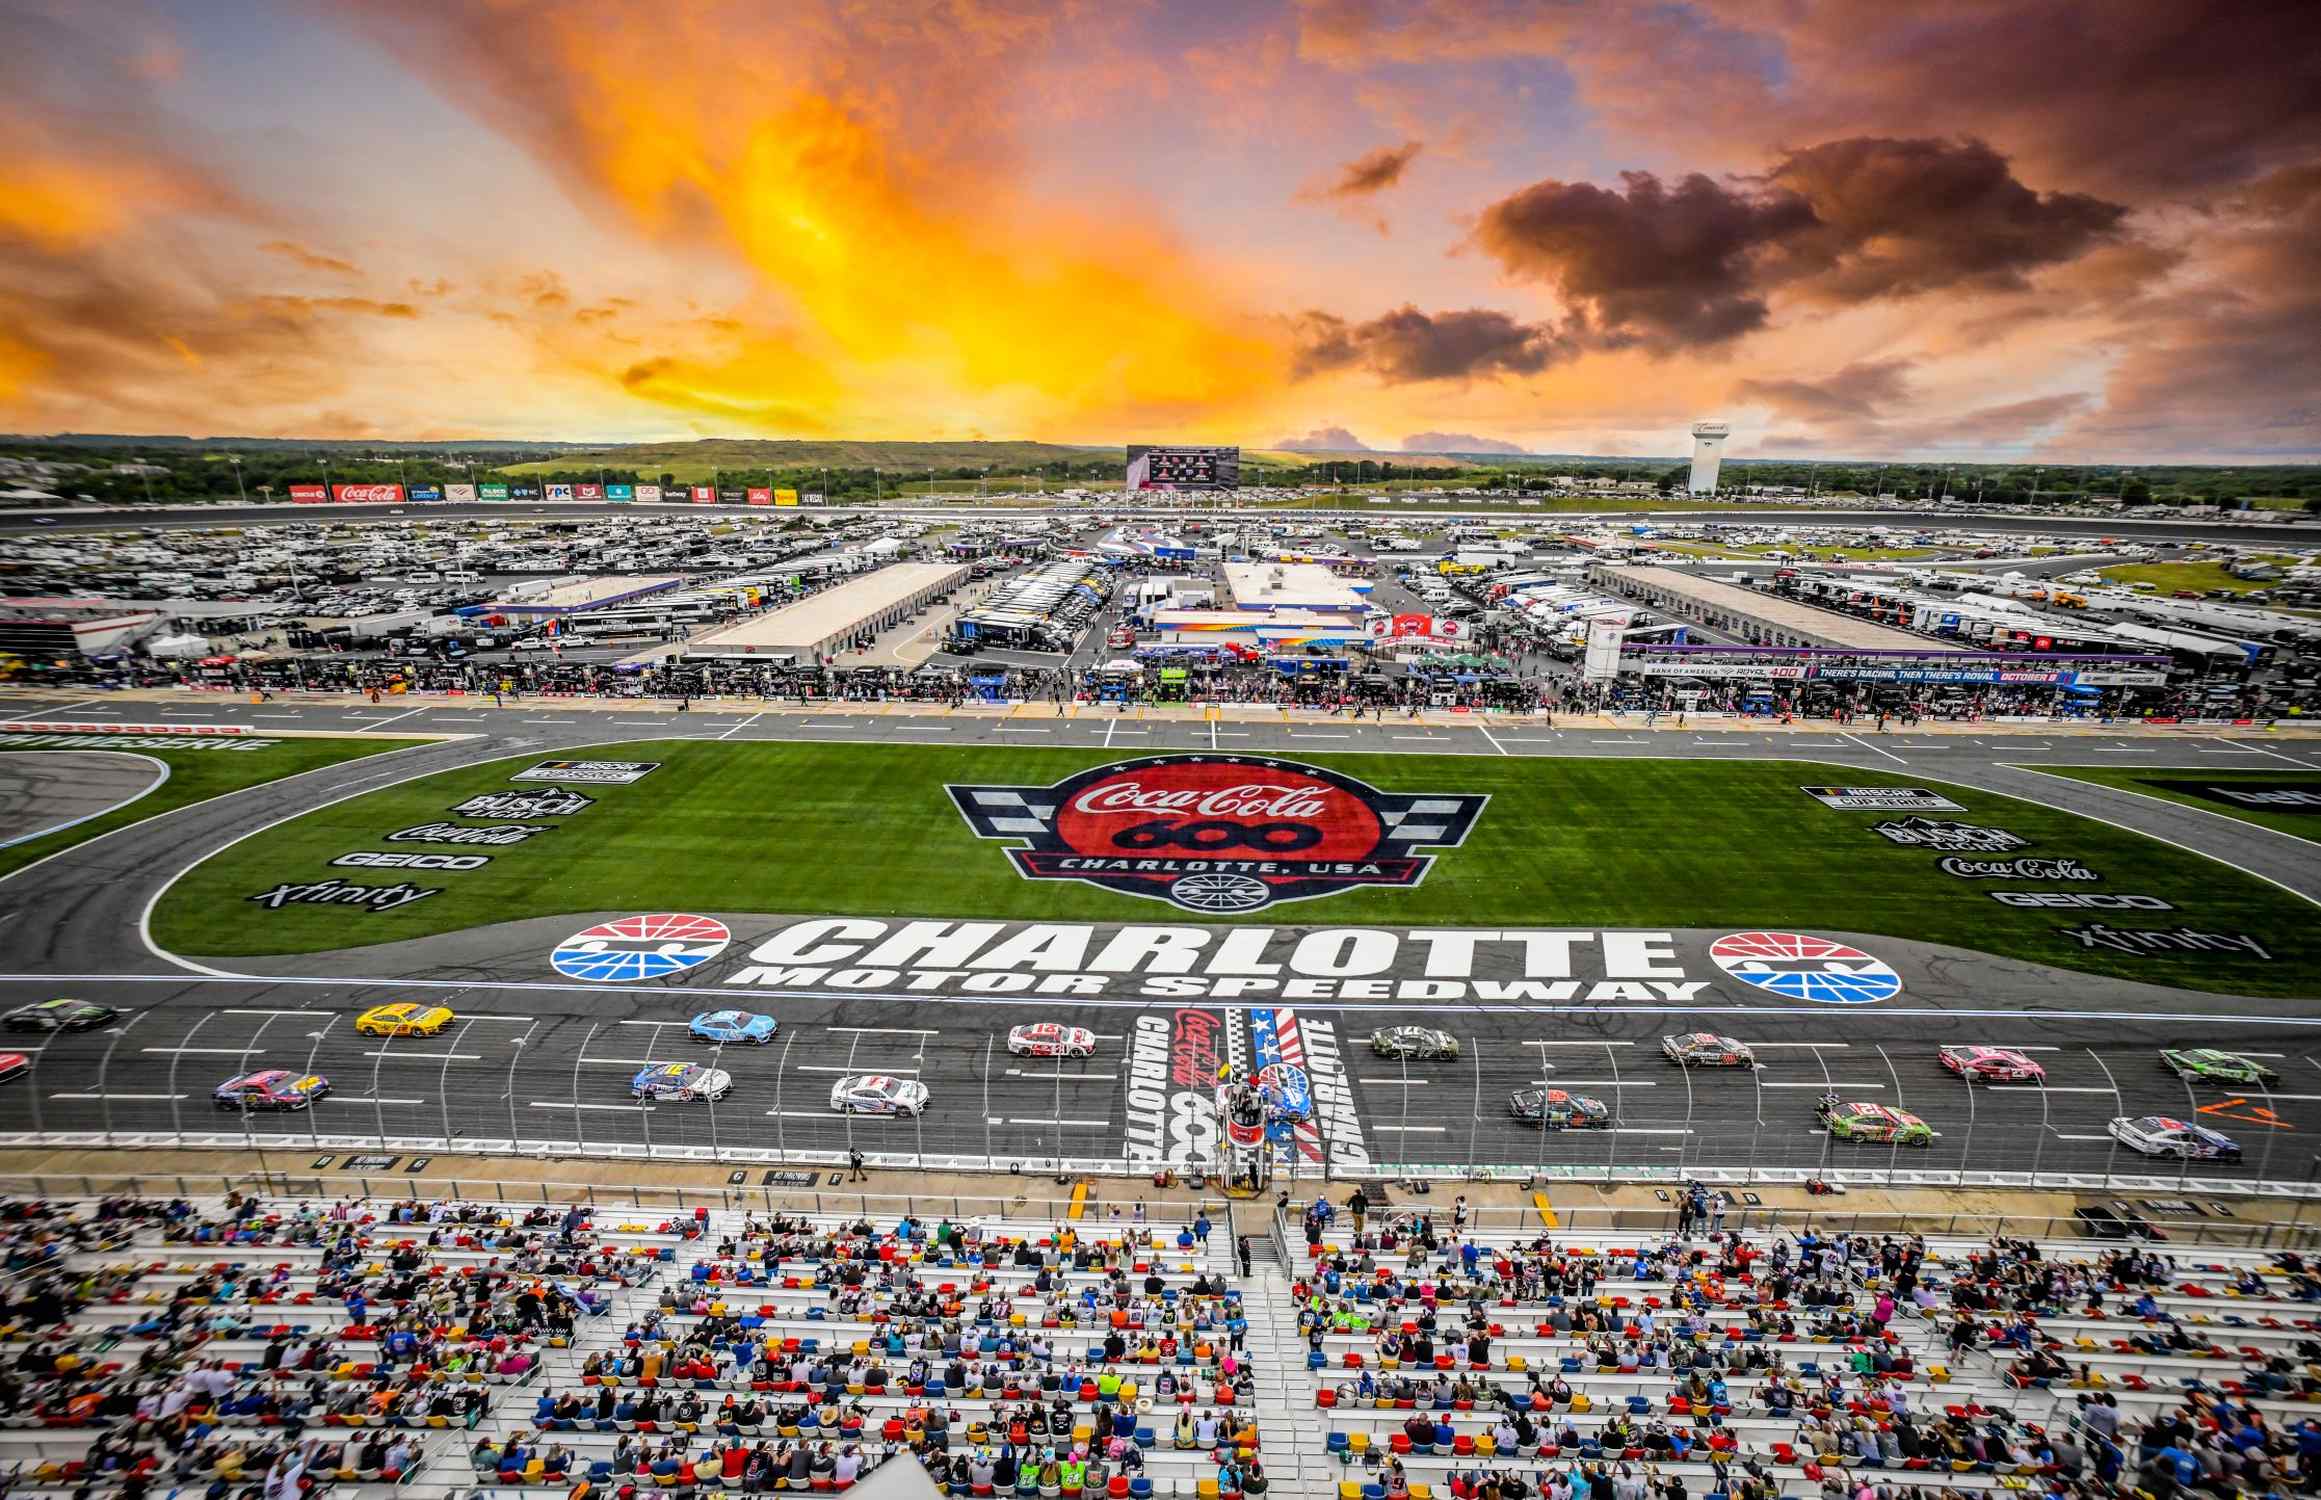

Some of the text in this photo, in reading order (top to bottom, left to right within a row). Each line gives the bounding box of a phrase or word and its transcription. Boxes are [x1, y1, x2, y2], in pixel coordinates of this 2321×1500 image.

[341, 485, 396, 502] Coca-Cola
[1684, 668, 1718, 676] AMERICA
[1769, 668, 1798, 677] 400
[1820, 669, 1994, 681] THERE'S RACING, THEN THERE'S ROVAL
[2001, 672, 2048, 682] OCTOBER
[1075, 781, 1336, 818] Coca-Cola
[1839, 797, 1938, 808] CUP SERIES
[1847, 788, 1917, 797] NASCAR
[453, 795, 594, 815] BUSCH
[465, 810, 545, 819] LIGHT
[1112, 820, 1324, 853] 600
[1874, 826, 2031, 846] BUSCH
[1929, 842, 2010, 851] LIGHT
[332, 852, 489, 869] GEICO
[1059, 857, 1381, 875] CHARLOTTE, USA
[1940, 857, 2098, 881] Coca-Cola
[253, 880, 438, 911] xfinity
[1990, 892, 2175, 910] GEICO
[748, 919, 1685, 978] CHARLOTTE
[2060, 924, 2273, 959] xfinity
[723, 966, 1712, 1000] MOTOR SPEEDWAY
[1172, 1008, 1222, 1089] Coca-Cola
[1122, 1015, 1171, 1162] CHARLOTTE
[1299, 1017, 1370, 1166] CHARLOTTE
